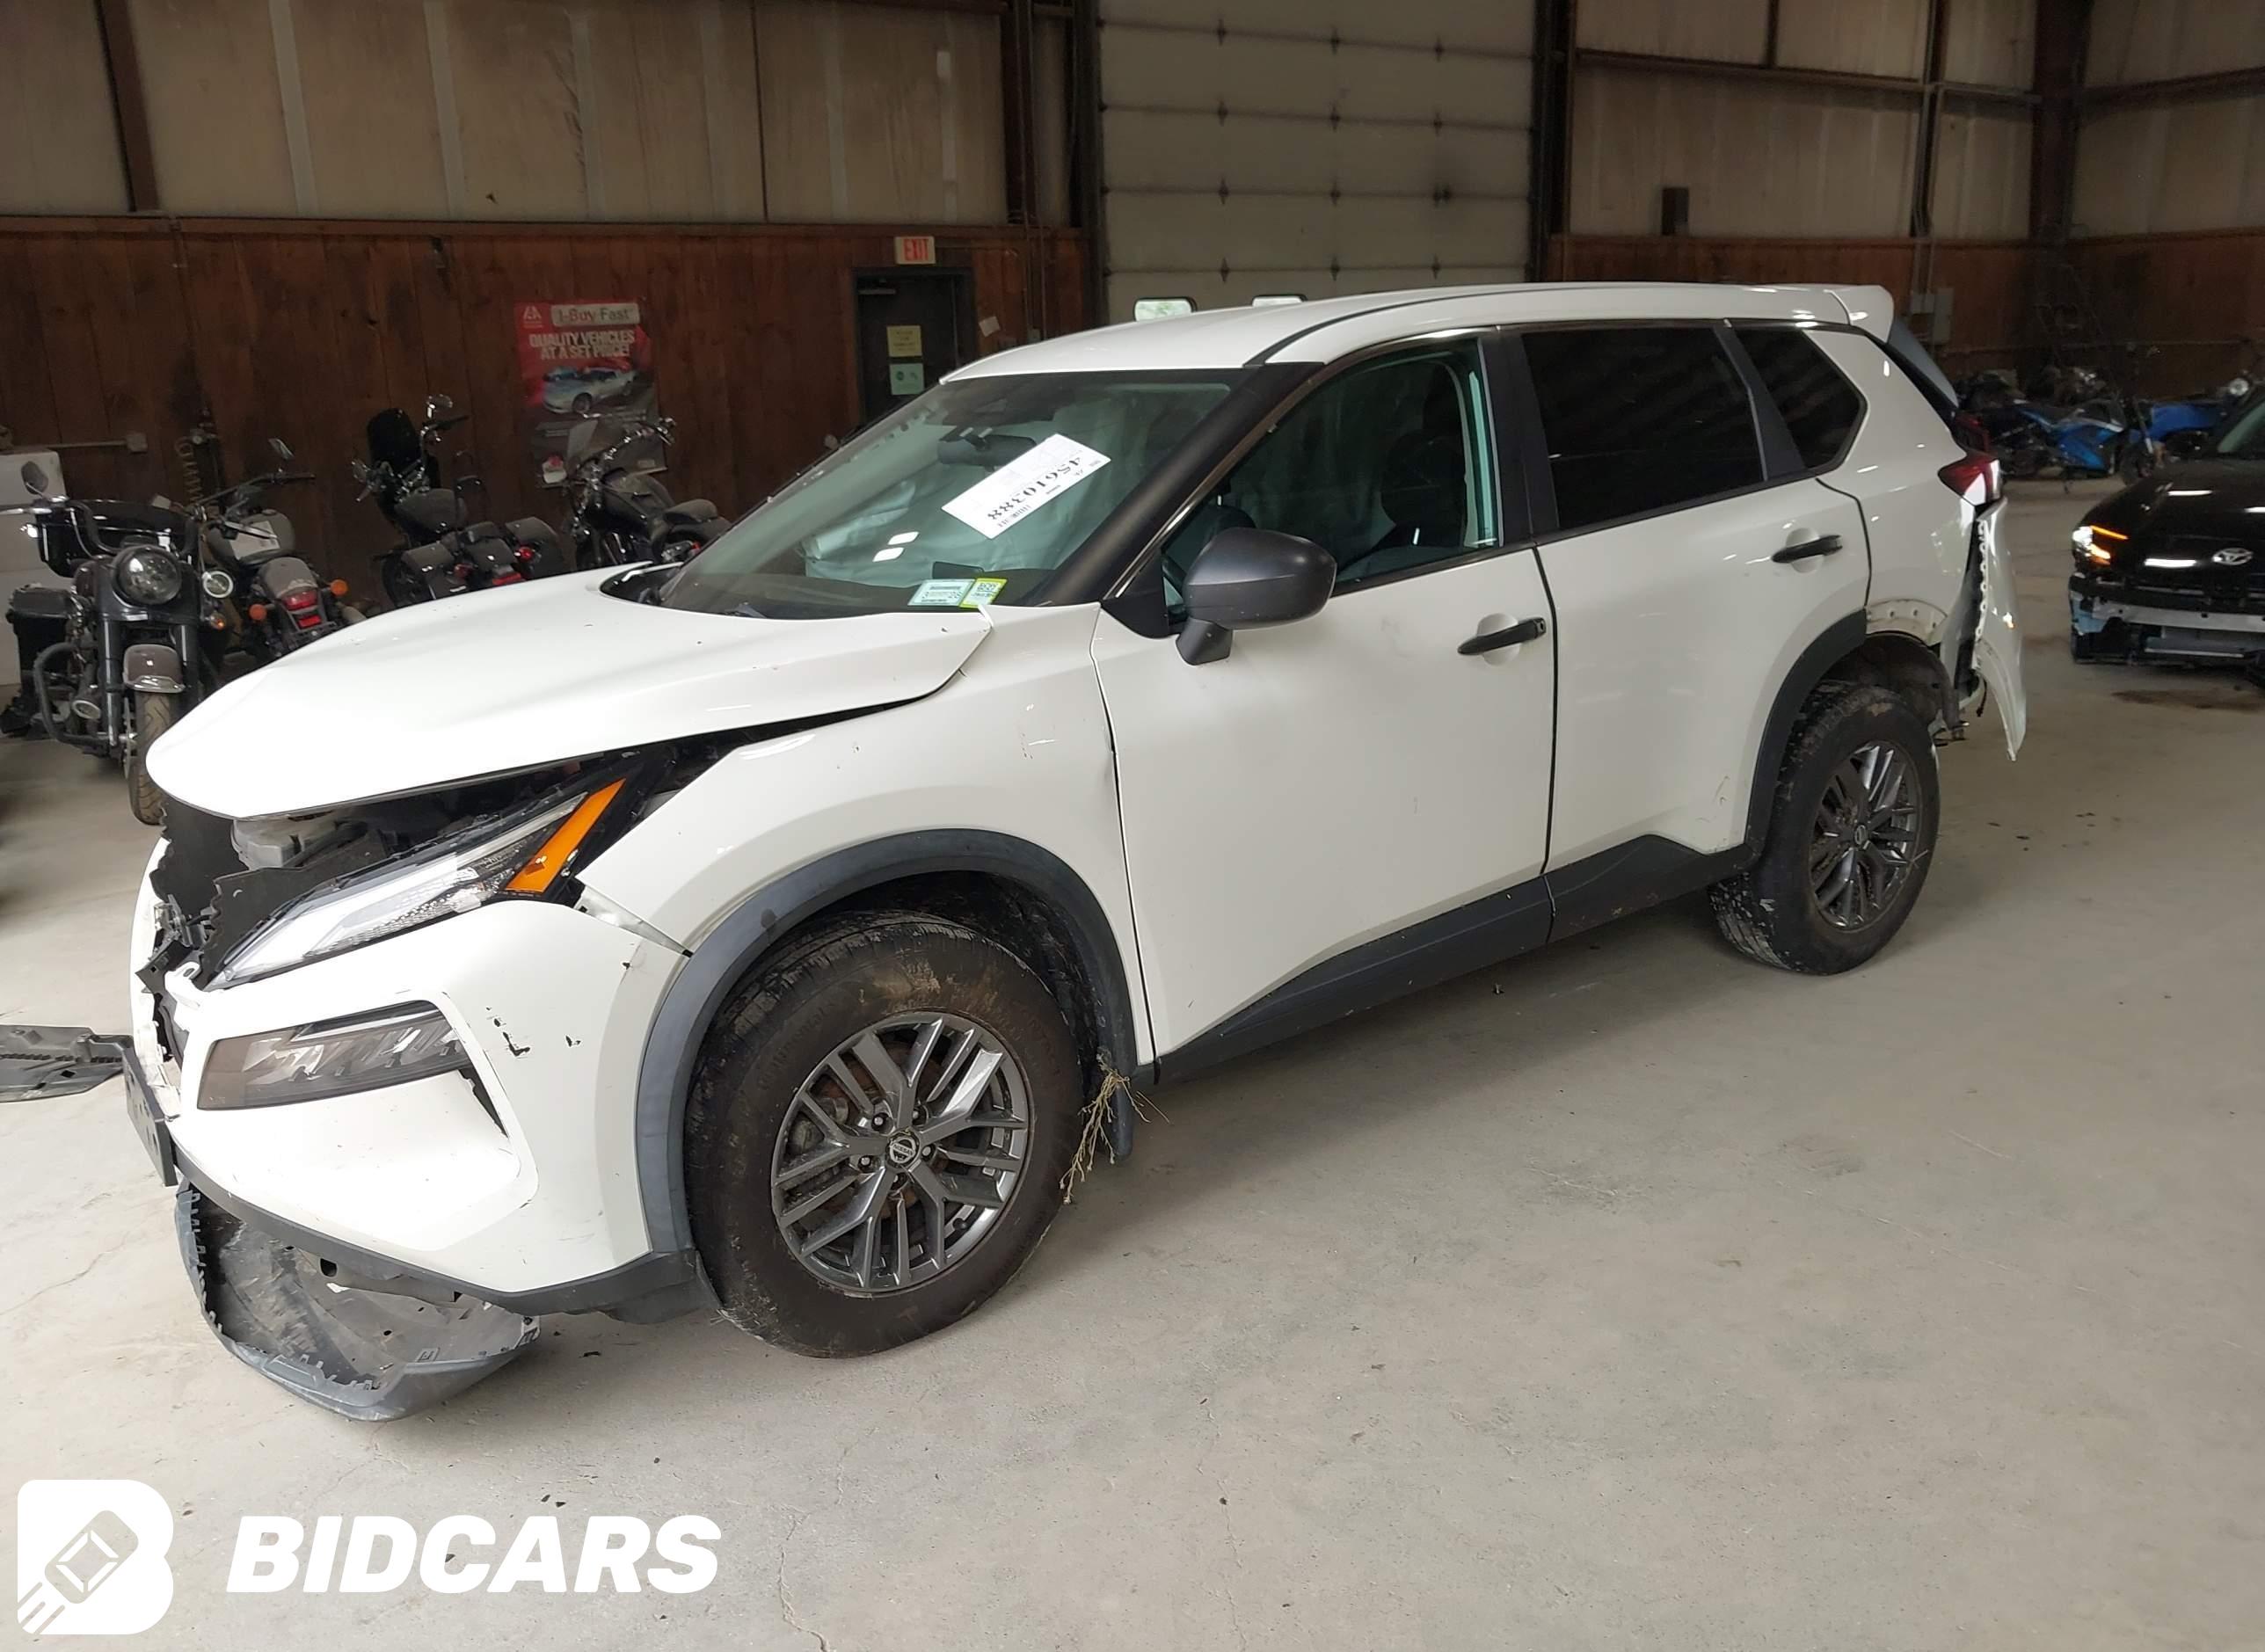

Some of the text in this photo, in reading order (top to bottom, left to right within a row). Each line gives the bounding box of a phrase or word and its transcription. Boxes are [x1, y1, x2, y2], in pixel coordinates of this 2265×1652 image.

[904, 238, 929, 261] EXIT
[600, 307, 630, 321] Fast
[528, 330, 636, 348] QUALITY VEHICLES
[541, 346, 557, 360] AT
[558, 346, 570, 360] A
[569, 345, 591, 359] SET
[987, 457, 1081, 520] 45610388
